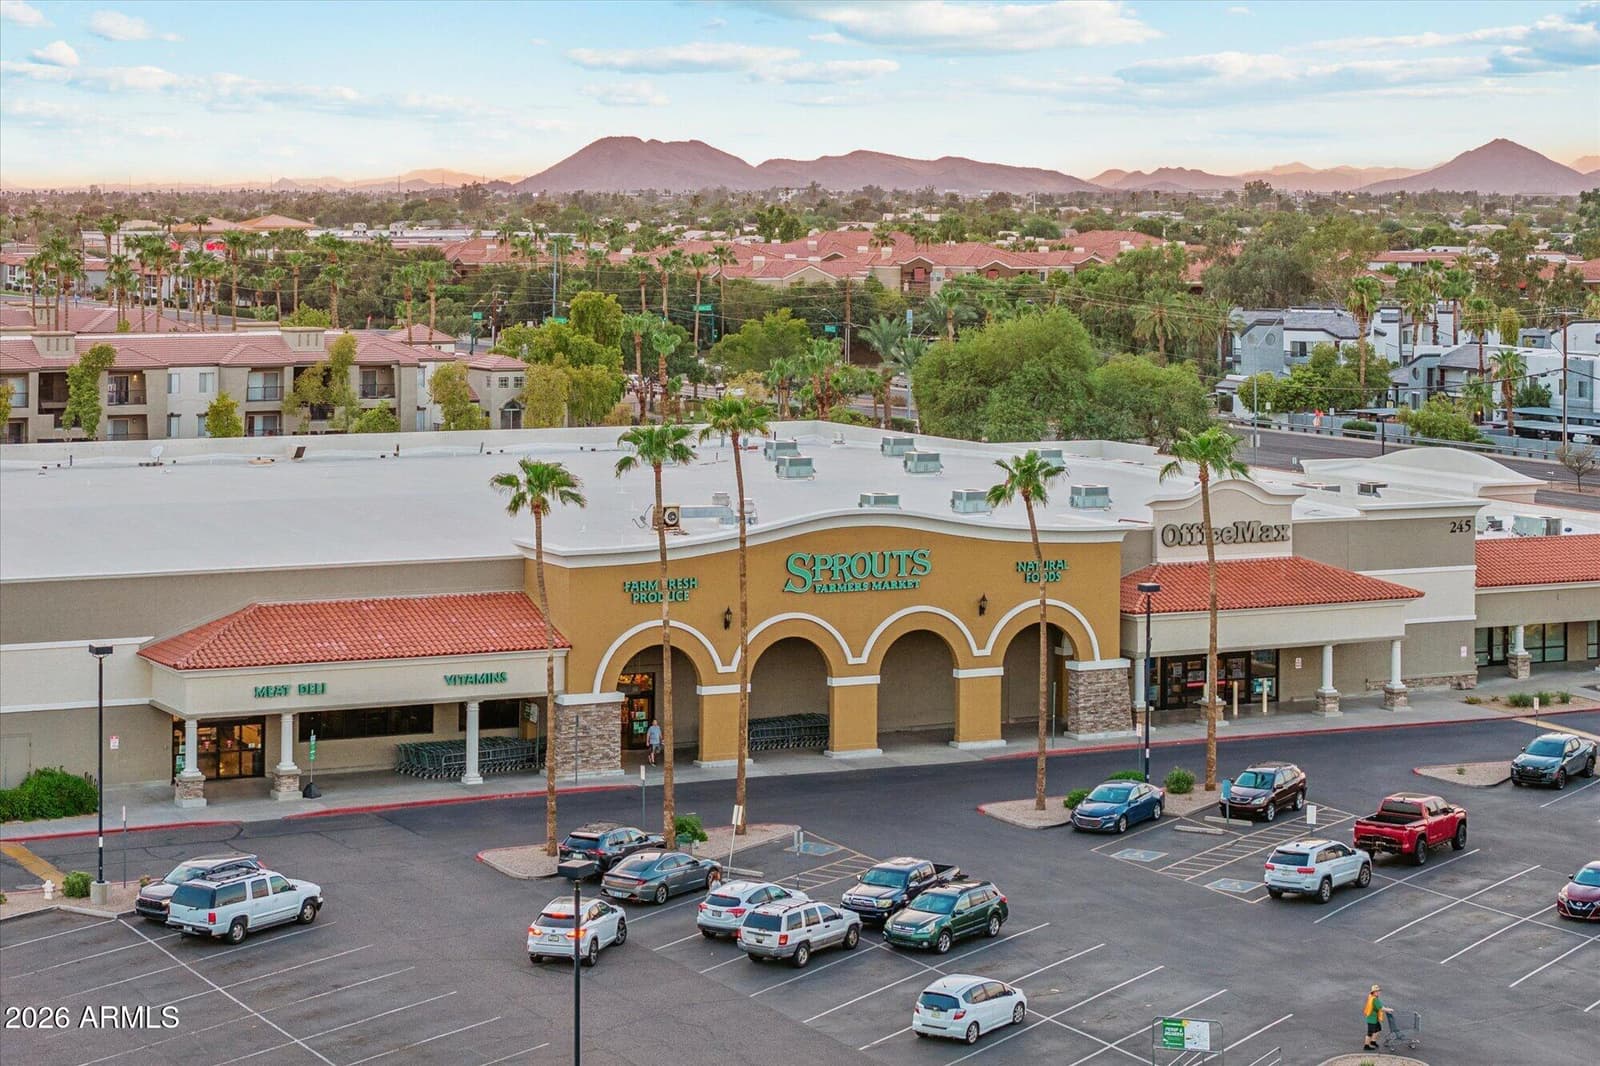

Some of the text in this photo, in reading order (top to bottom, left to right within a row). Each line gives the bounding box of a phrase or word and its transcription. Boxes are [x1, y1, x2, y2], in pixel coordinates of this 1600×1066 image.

[1161, 520, 1290, 547] OfficeMax
[1449, 519, 1471, 533] 245
[783, 548, 931, 594] SPROUTS
[1024, 571, 1061, 583] FOODS
[623, 577, 698, 592] FARM RESH
[814, 579, 920, 594] FARMERS MARKET
[443, 671, 508, 686] VITAMINS
[254, 682, 327, 698] MEAT DELI
